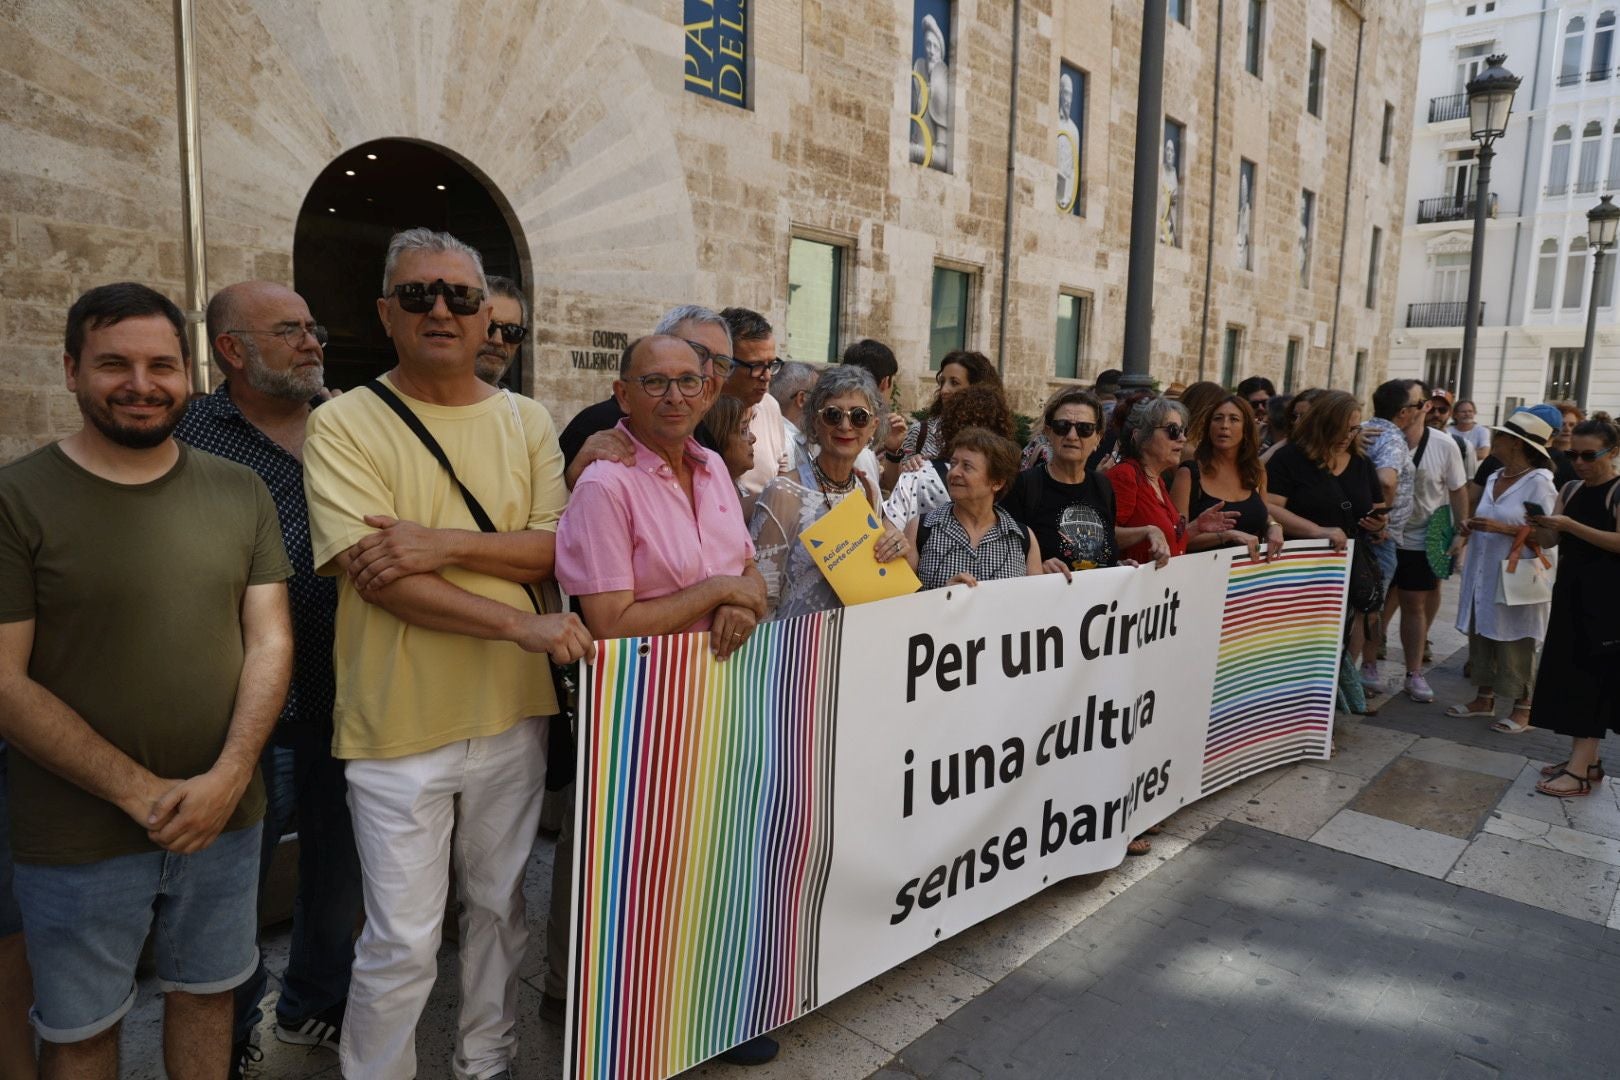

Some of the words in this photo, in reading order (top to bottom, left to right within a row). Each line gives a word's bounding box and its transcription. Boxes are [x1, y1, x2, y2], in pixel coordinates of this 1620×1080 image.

[571, 351, 620, 371] VALENCI
[593, 330, 628, 350] CORTS
[907, 633, 986, 703] Per
[1002, 626, 1064, 678] un
[1080, 588, 1181, 661] Circuit
[903, 749, 915, 819] i
[931, 737, 1025, 806] una
[1036, 690, 1156, 766] cultura
[890, 827, 1028, 926] sense
